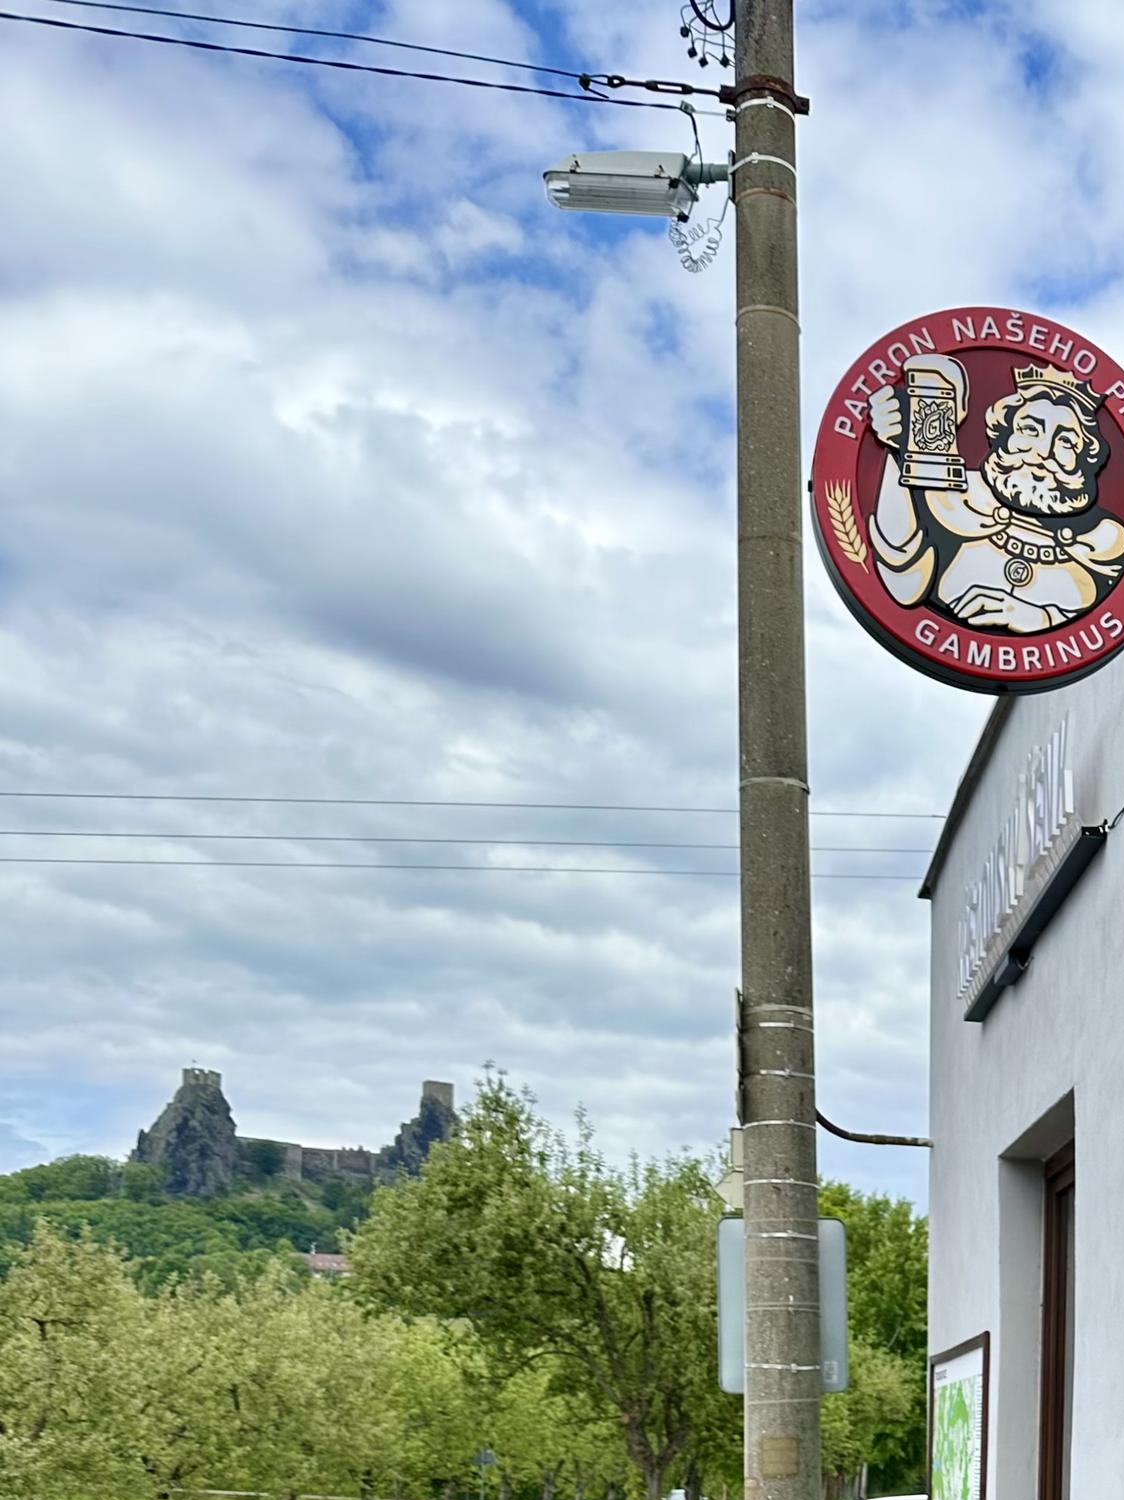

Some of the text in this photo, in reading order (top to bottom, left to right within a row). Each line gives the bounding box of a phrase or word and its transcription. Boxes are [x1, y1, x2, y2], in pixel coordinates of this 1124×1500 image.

[835, 328, 936, 439] PATRON
[952, 313, 1097, 376] NAŠEHO
[915, 611, 1124, 671] GAMBRINUS
